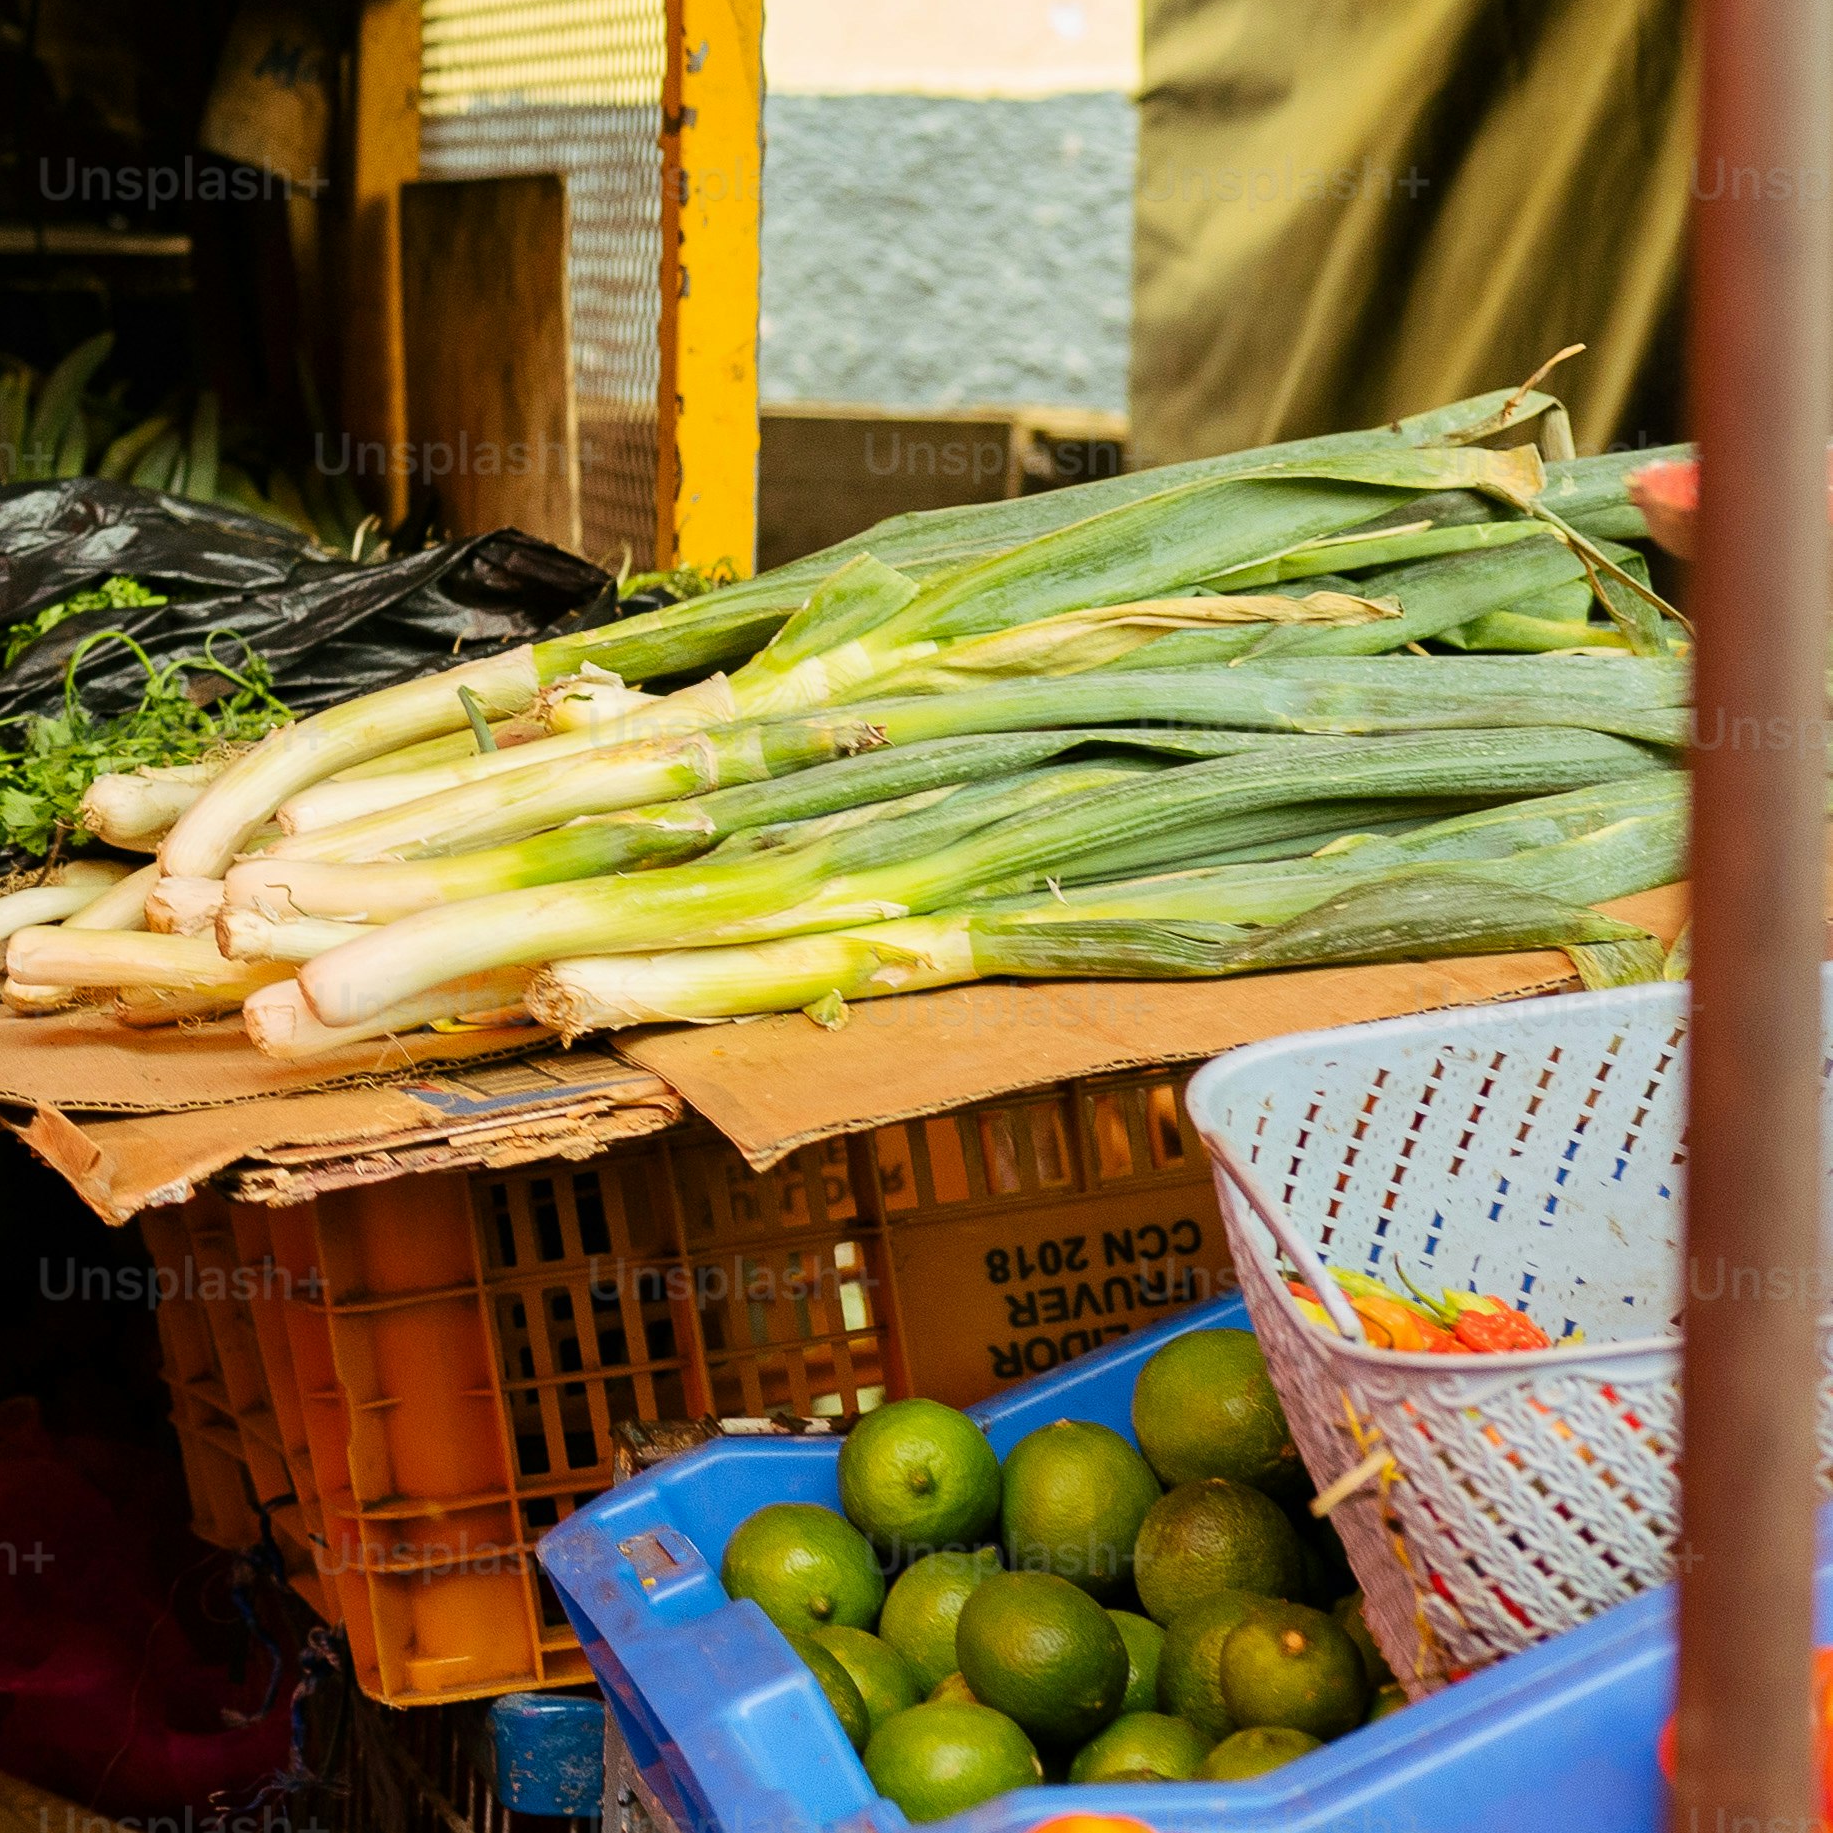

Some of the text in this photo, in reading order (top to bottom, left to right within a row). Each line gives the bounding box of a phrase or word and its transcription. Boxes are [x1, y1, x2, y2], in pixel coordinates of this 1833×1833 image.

[986, 1236, 1090, 1285] 2018
[1104, 1219, 1203, 1267] CCN
[1004, 1266, 1198, 1329] FRUVER
